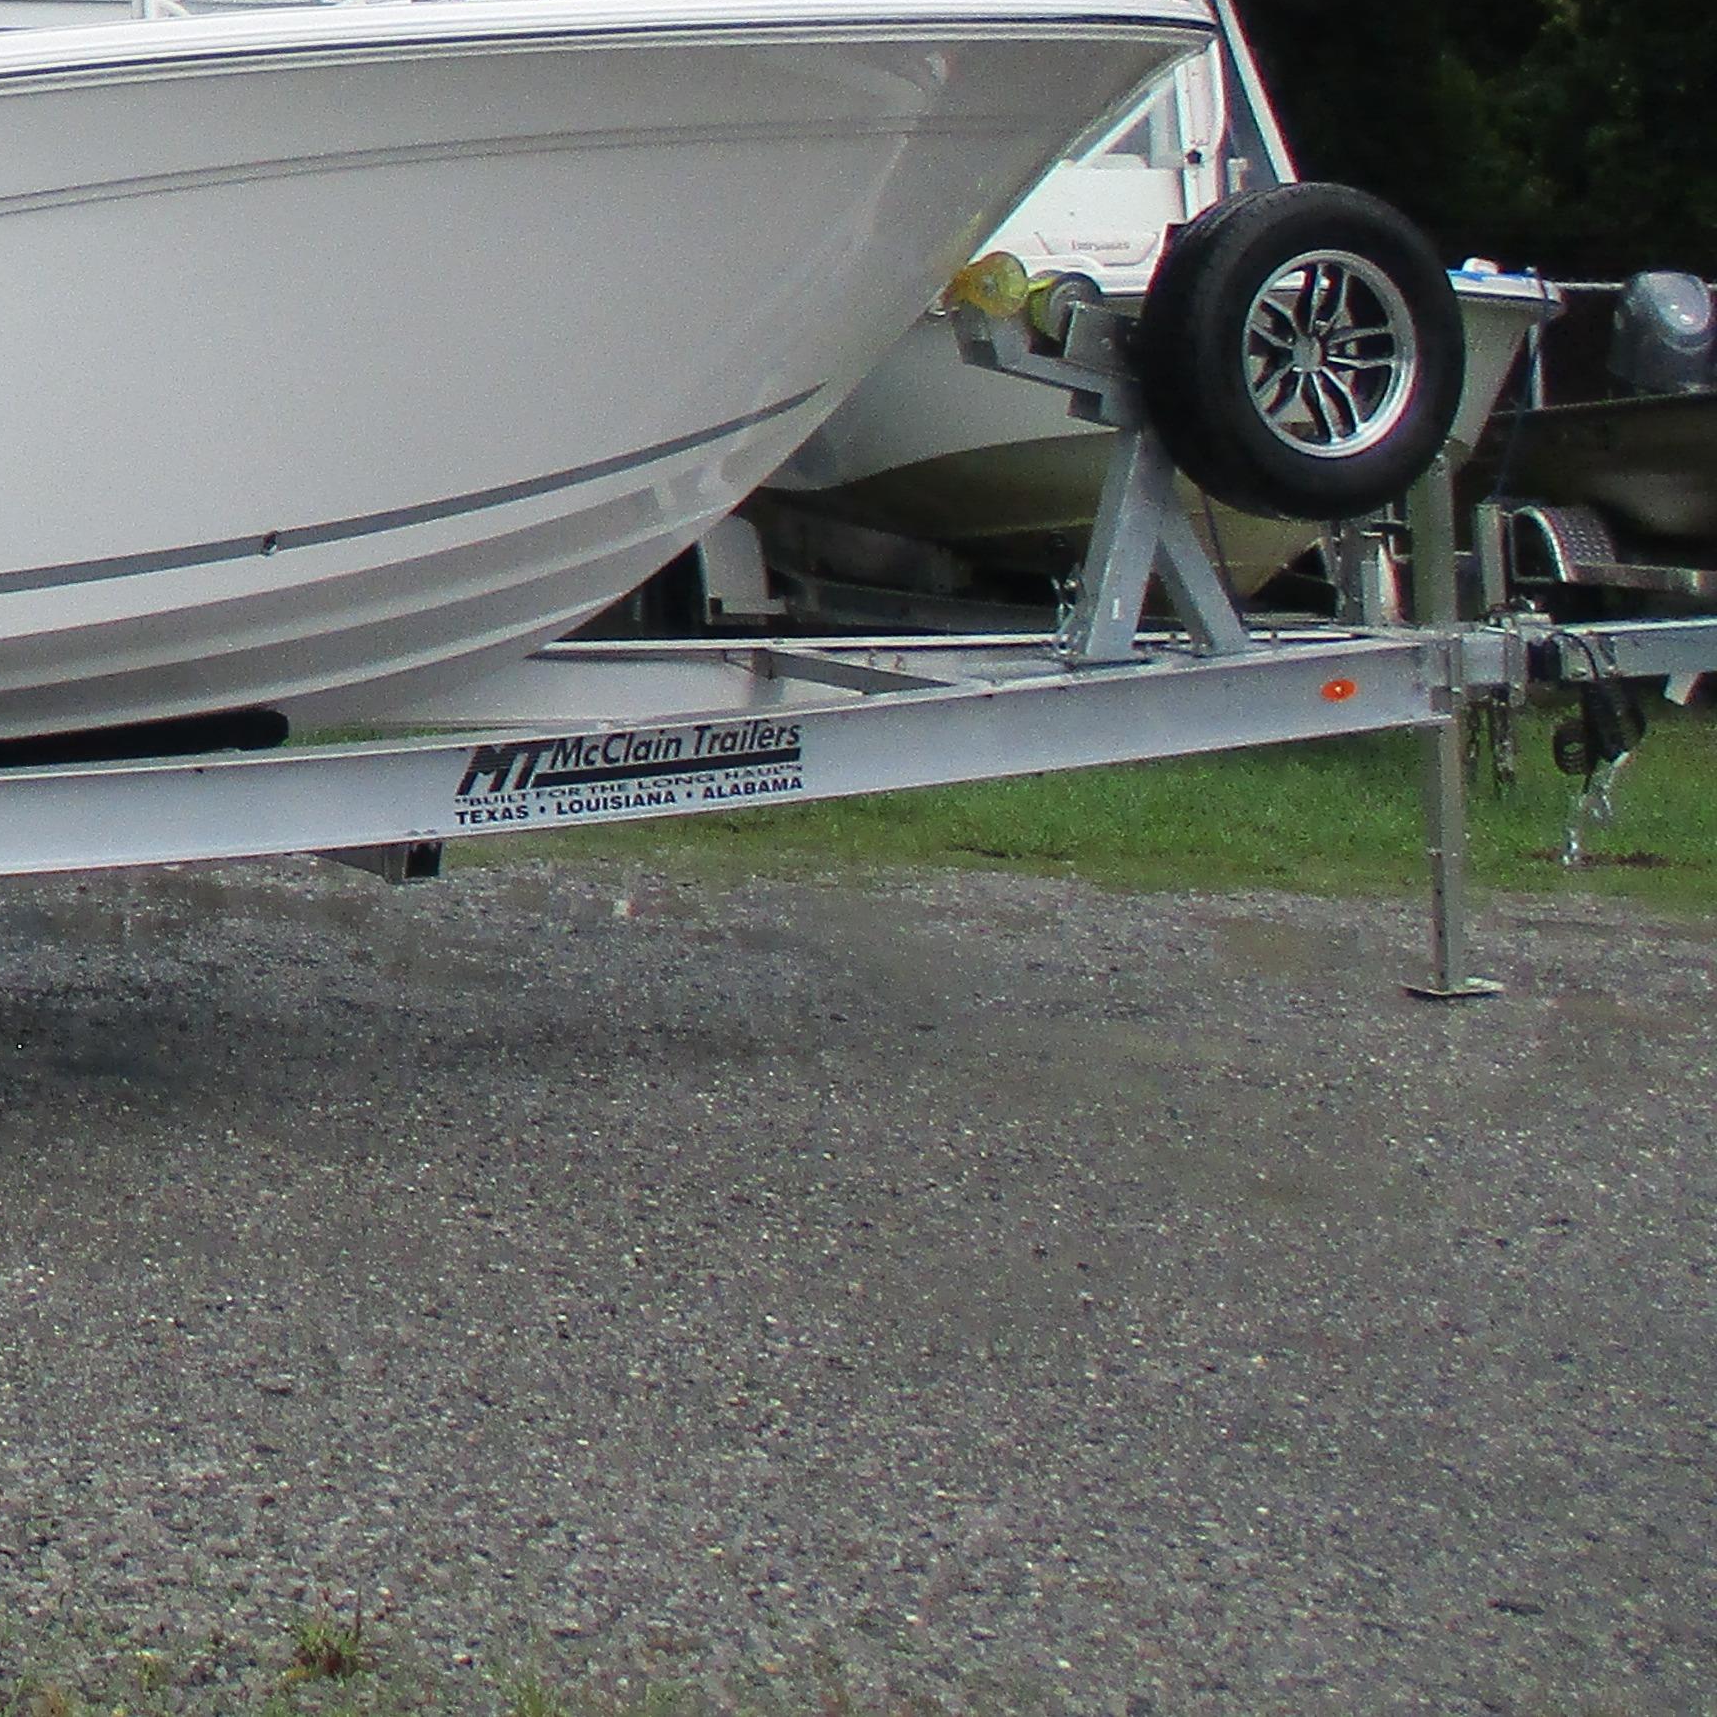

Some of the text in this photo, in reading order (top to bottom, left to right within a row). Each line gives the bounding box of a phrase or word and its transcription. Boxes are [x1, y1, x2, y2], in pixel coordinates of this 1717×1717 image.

[549, 728, 683, 770] McClain
[693, 718, 803, 756] Trailers
[454, 777, 803, 825] TEXAS LOUISIANA ALABAMA
[534, 786, 582, 800] FOR
[587, 781, 630, 796] THE
[637, 773, 715, 790] LONG
